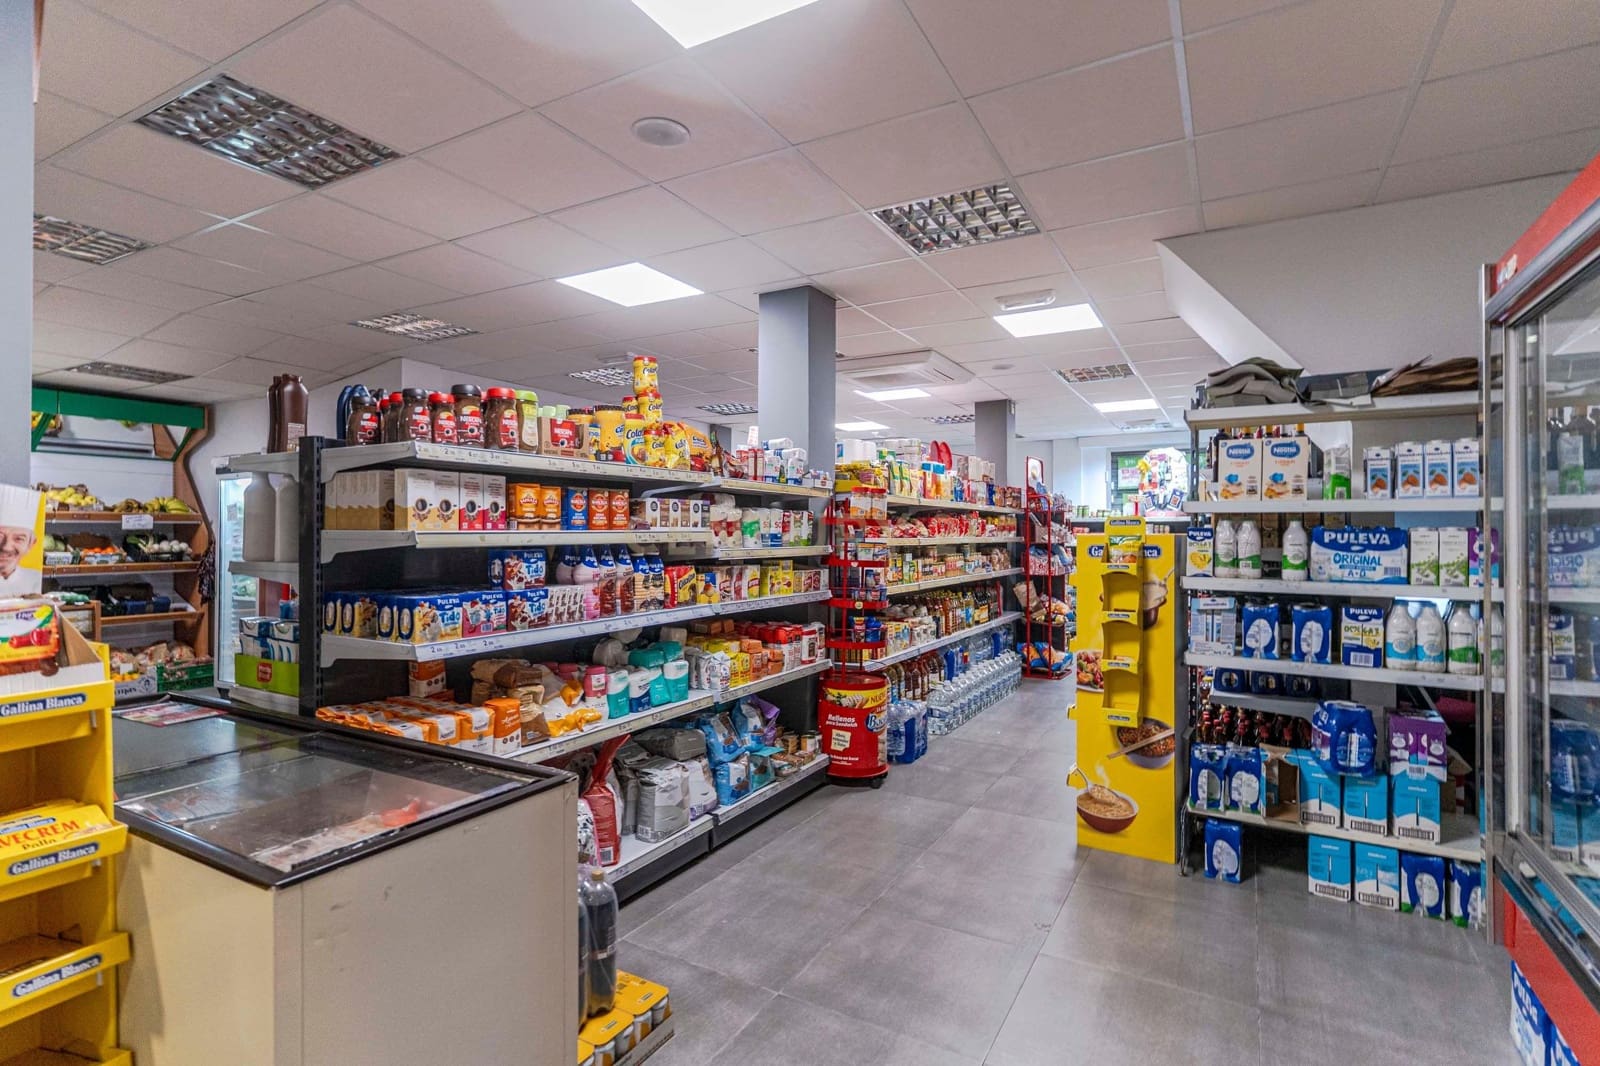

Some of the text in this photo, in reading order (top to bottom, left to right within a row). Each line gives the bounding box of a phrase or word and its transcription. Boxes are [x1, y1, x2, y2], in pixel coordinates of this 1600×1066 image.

[1324, 531, 1391, 545] PULEVA
[1333, 552, 1383, 566] ORIGINAL
[1350, 607, 1378, 615] PULEVA
[1, 695, 83, 716] Gallina Blanca
[0, 820, 80, 849] VECREM
[12, 845, 96, 873] Gallina Blanca
[16, 958, 99, 996] Gallina Blanca
